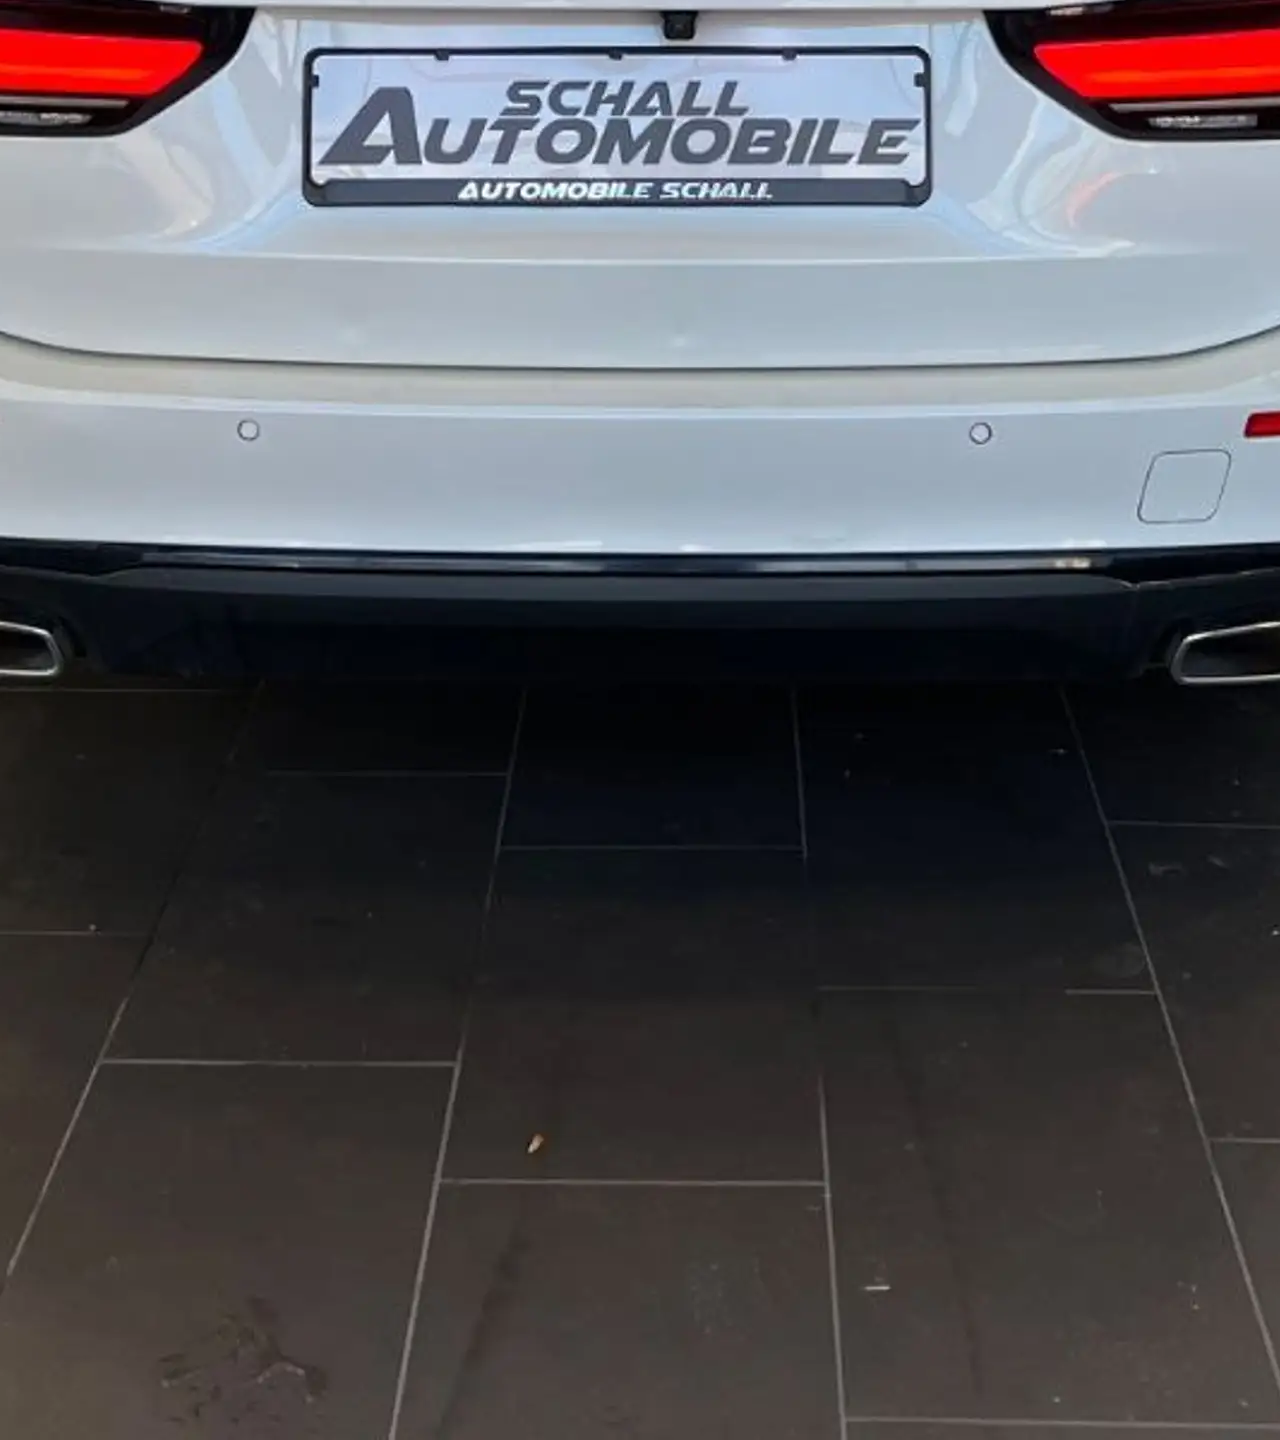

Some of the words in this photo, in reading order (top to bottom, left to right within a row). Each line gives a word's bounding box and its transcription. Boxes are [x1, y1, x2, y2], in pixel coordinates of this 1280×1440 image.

[503, 80, 749, 116] SCHALL
[319, 86, 920, 165] AUTOMOBILE
[457, 181, 650, 200] AUTOMOBILE
[659, 182, 773, 199] SCHALL
